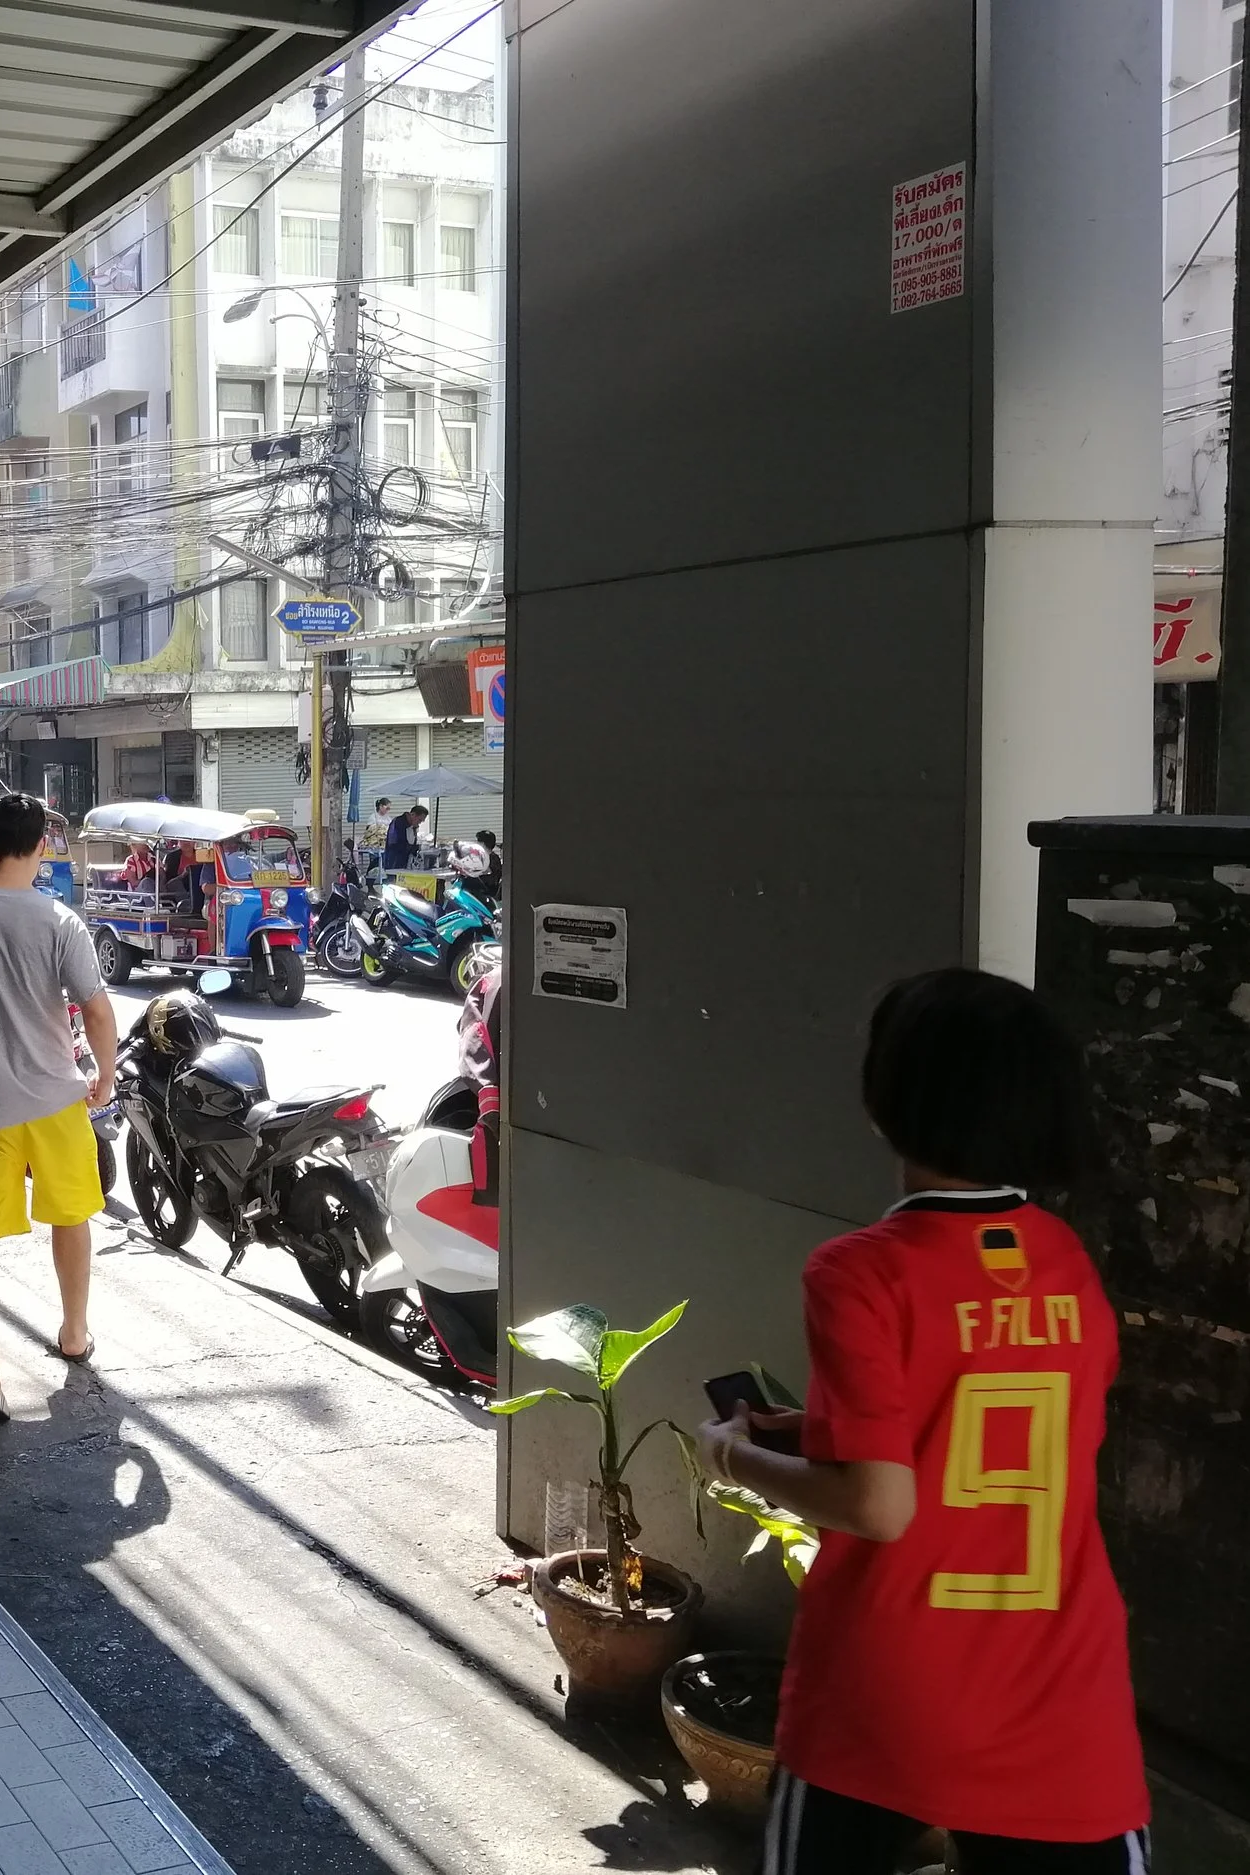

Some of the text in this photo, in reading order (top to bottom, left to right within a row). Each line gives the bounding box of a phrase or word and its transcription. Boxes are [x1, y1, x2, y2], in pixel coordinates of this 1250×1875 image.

[895, 171, 963, 207] รับสมัคร
[894, 194, 963, 231] พี่เลี้ยงเด็ก
[298, 603, 340, 618] สำโรงเหนือ
[341, 611, 350, 624] 2
[930, 1371, 1071, 1612] 9
